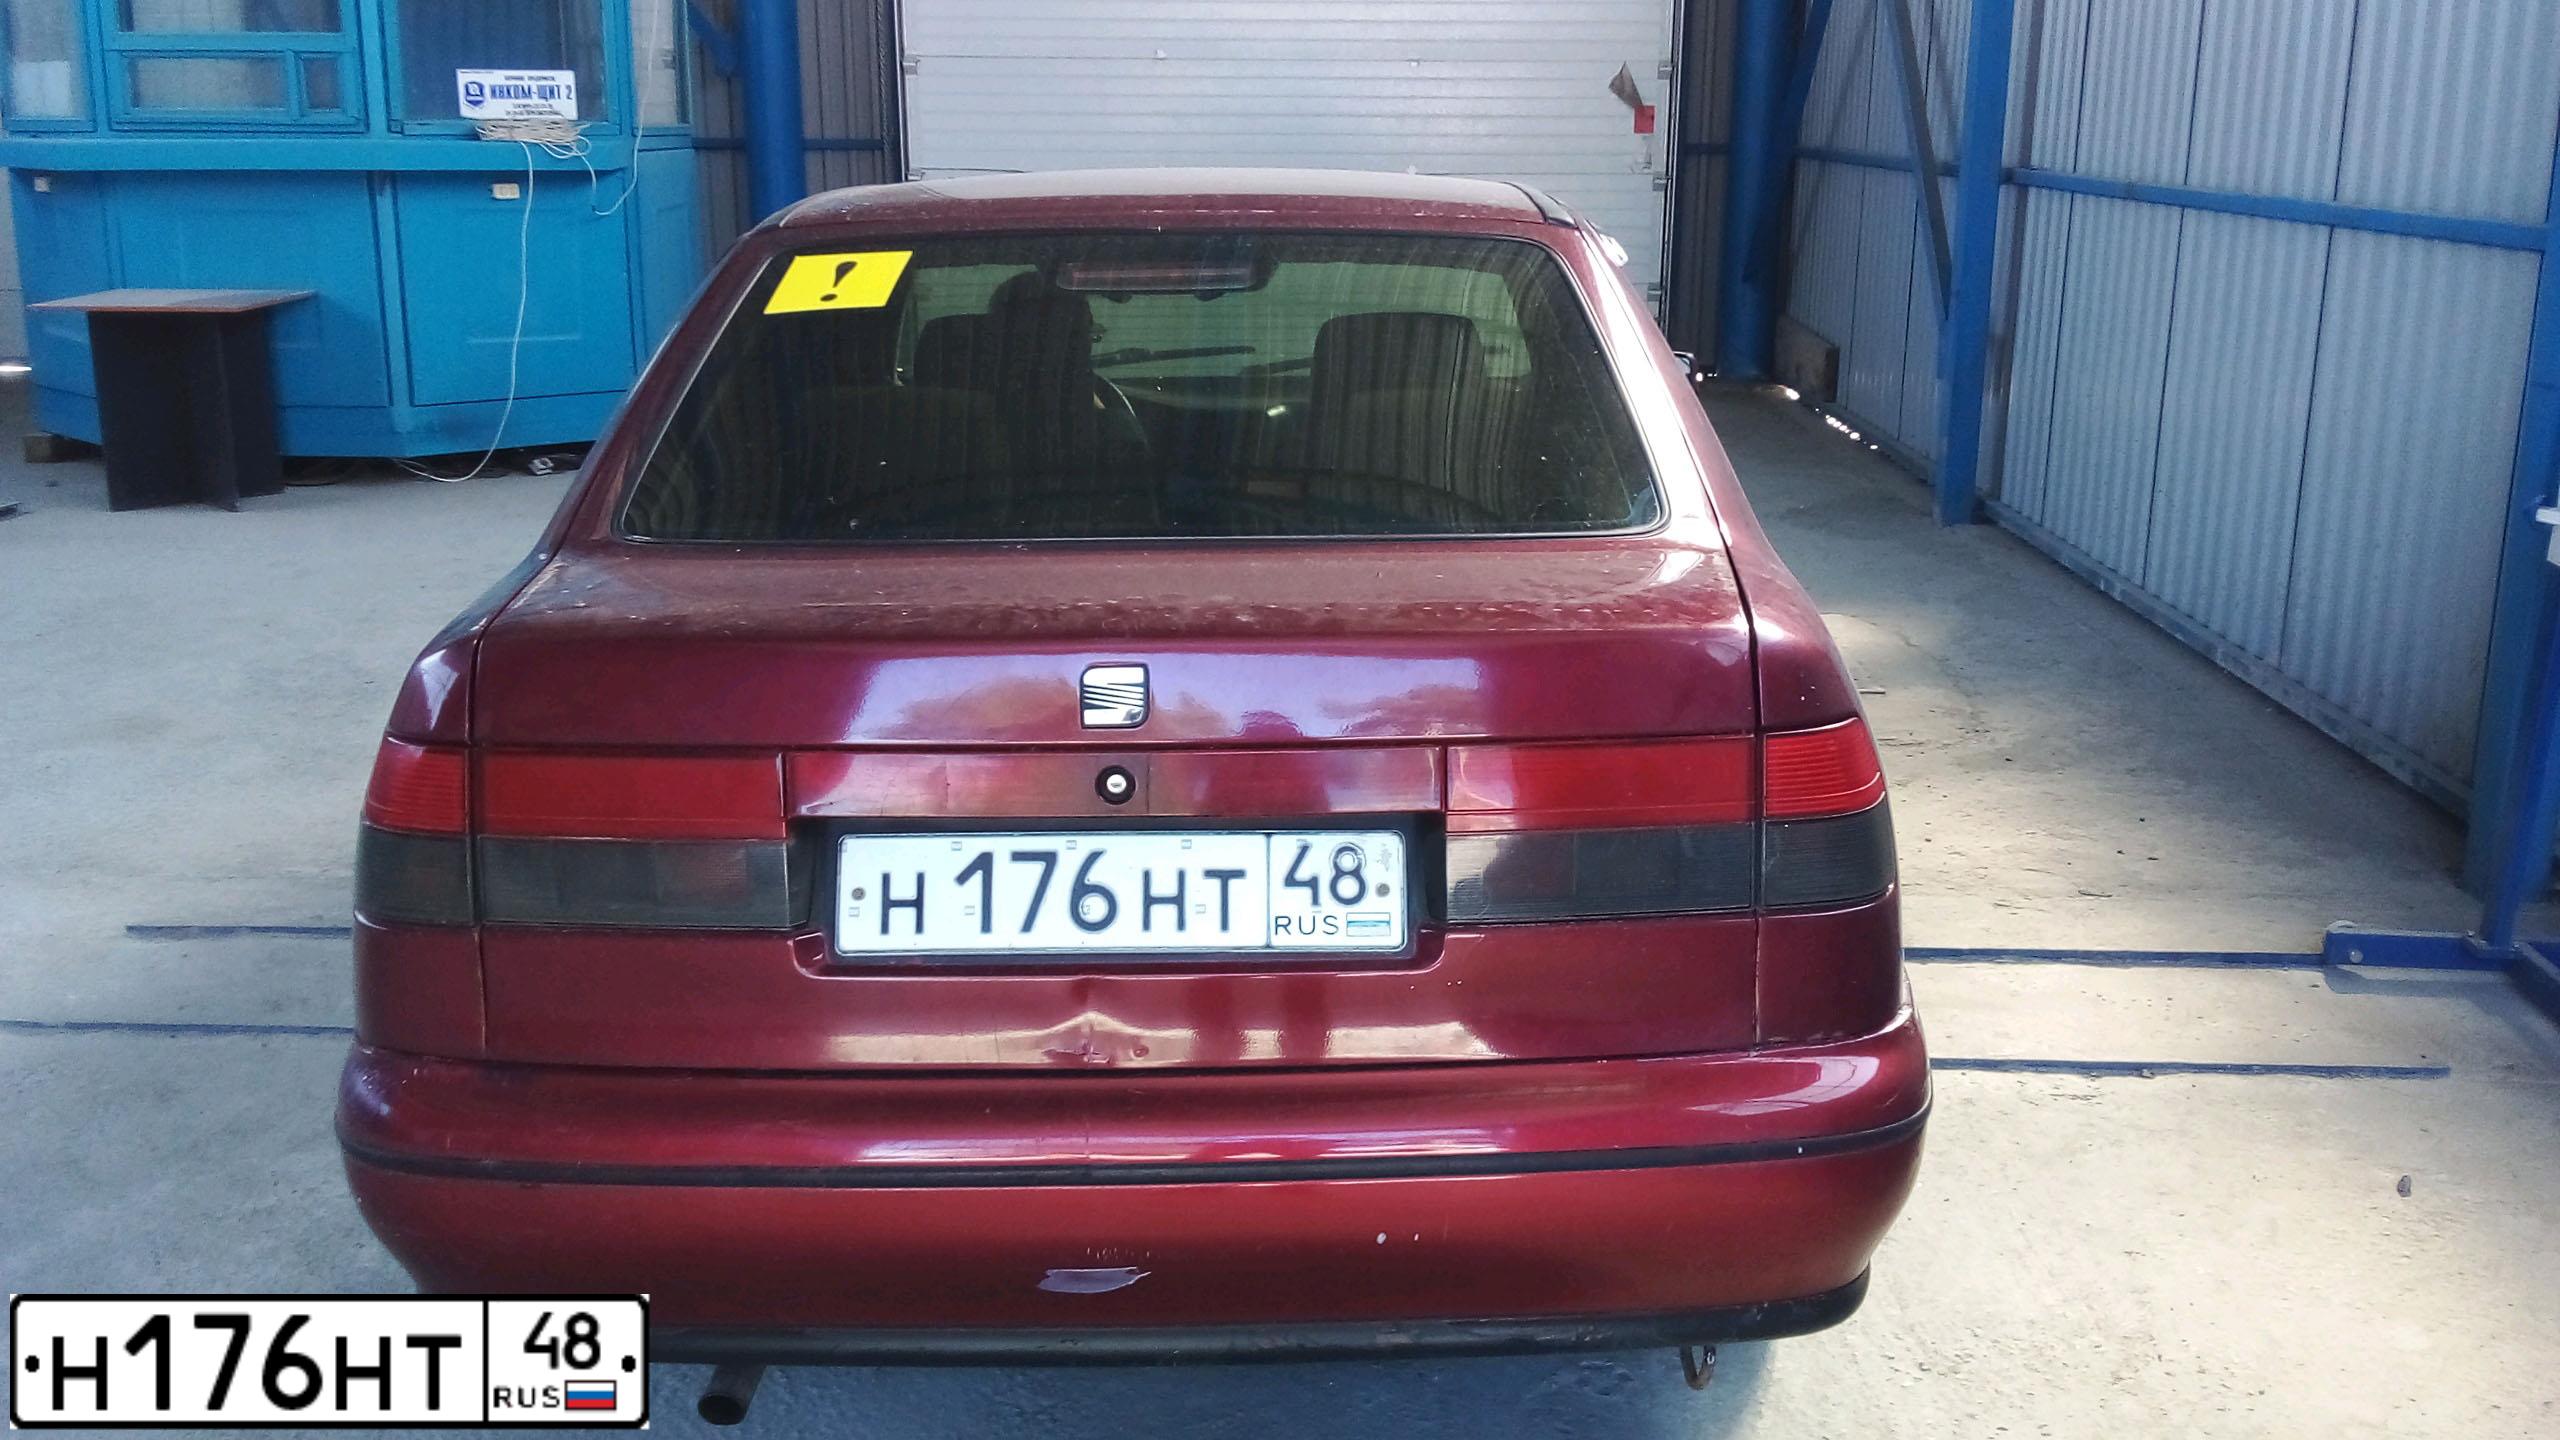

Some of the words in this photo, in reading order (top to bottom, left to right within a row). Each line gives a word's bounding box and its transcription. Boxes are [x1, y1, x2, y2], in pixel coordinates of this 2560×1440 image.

[565, 84, 573, 100] 2
[1284, 844, 1367, 906] 48
[1274, 914, 1340, 936] RUS
